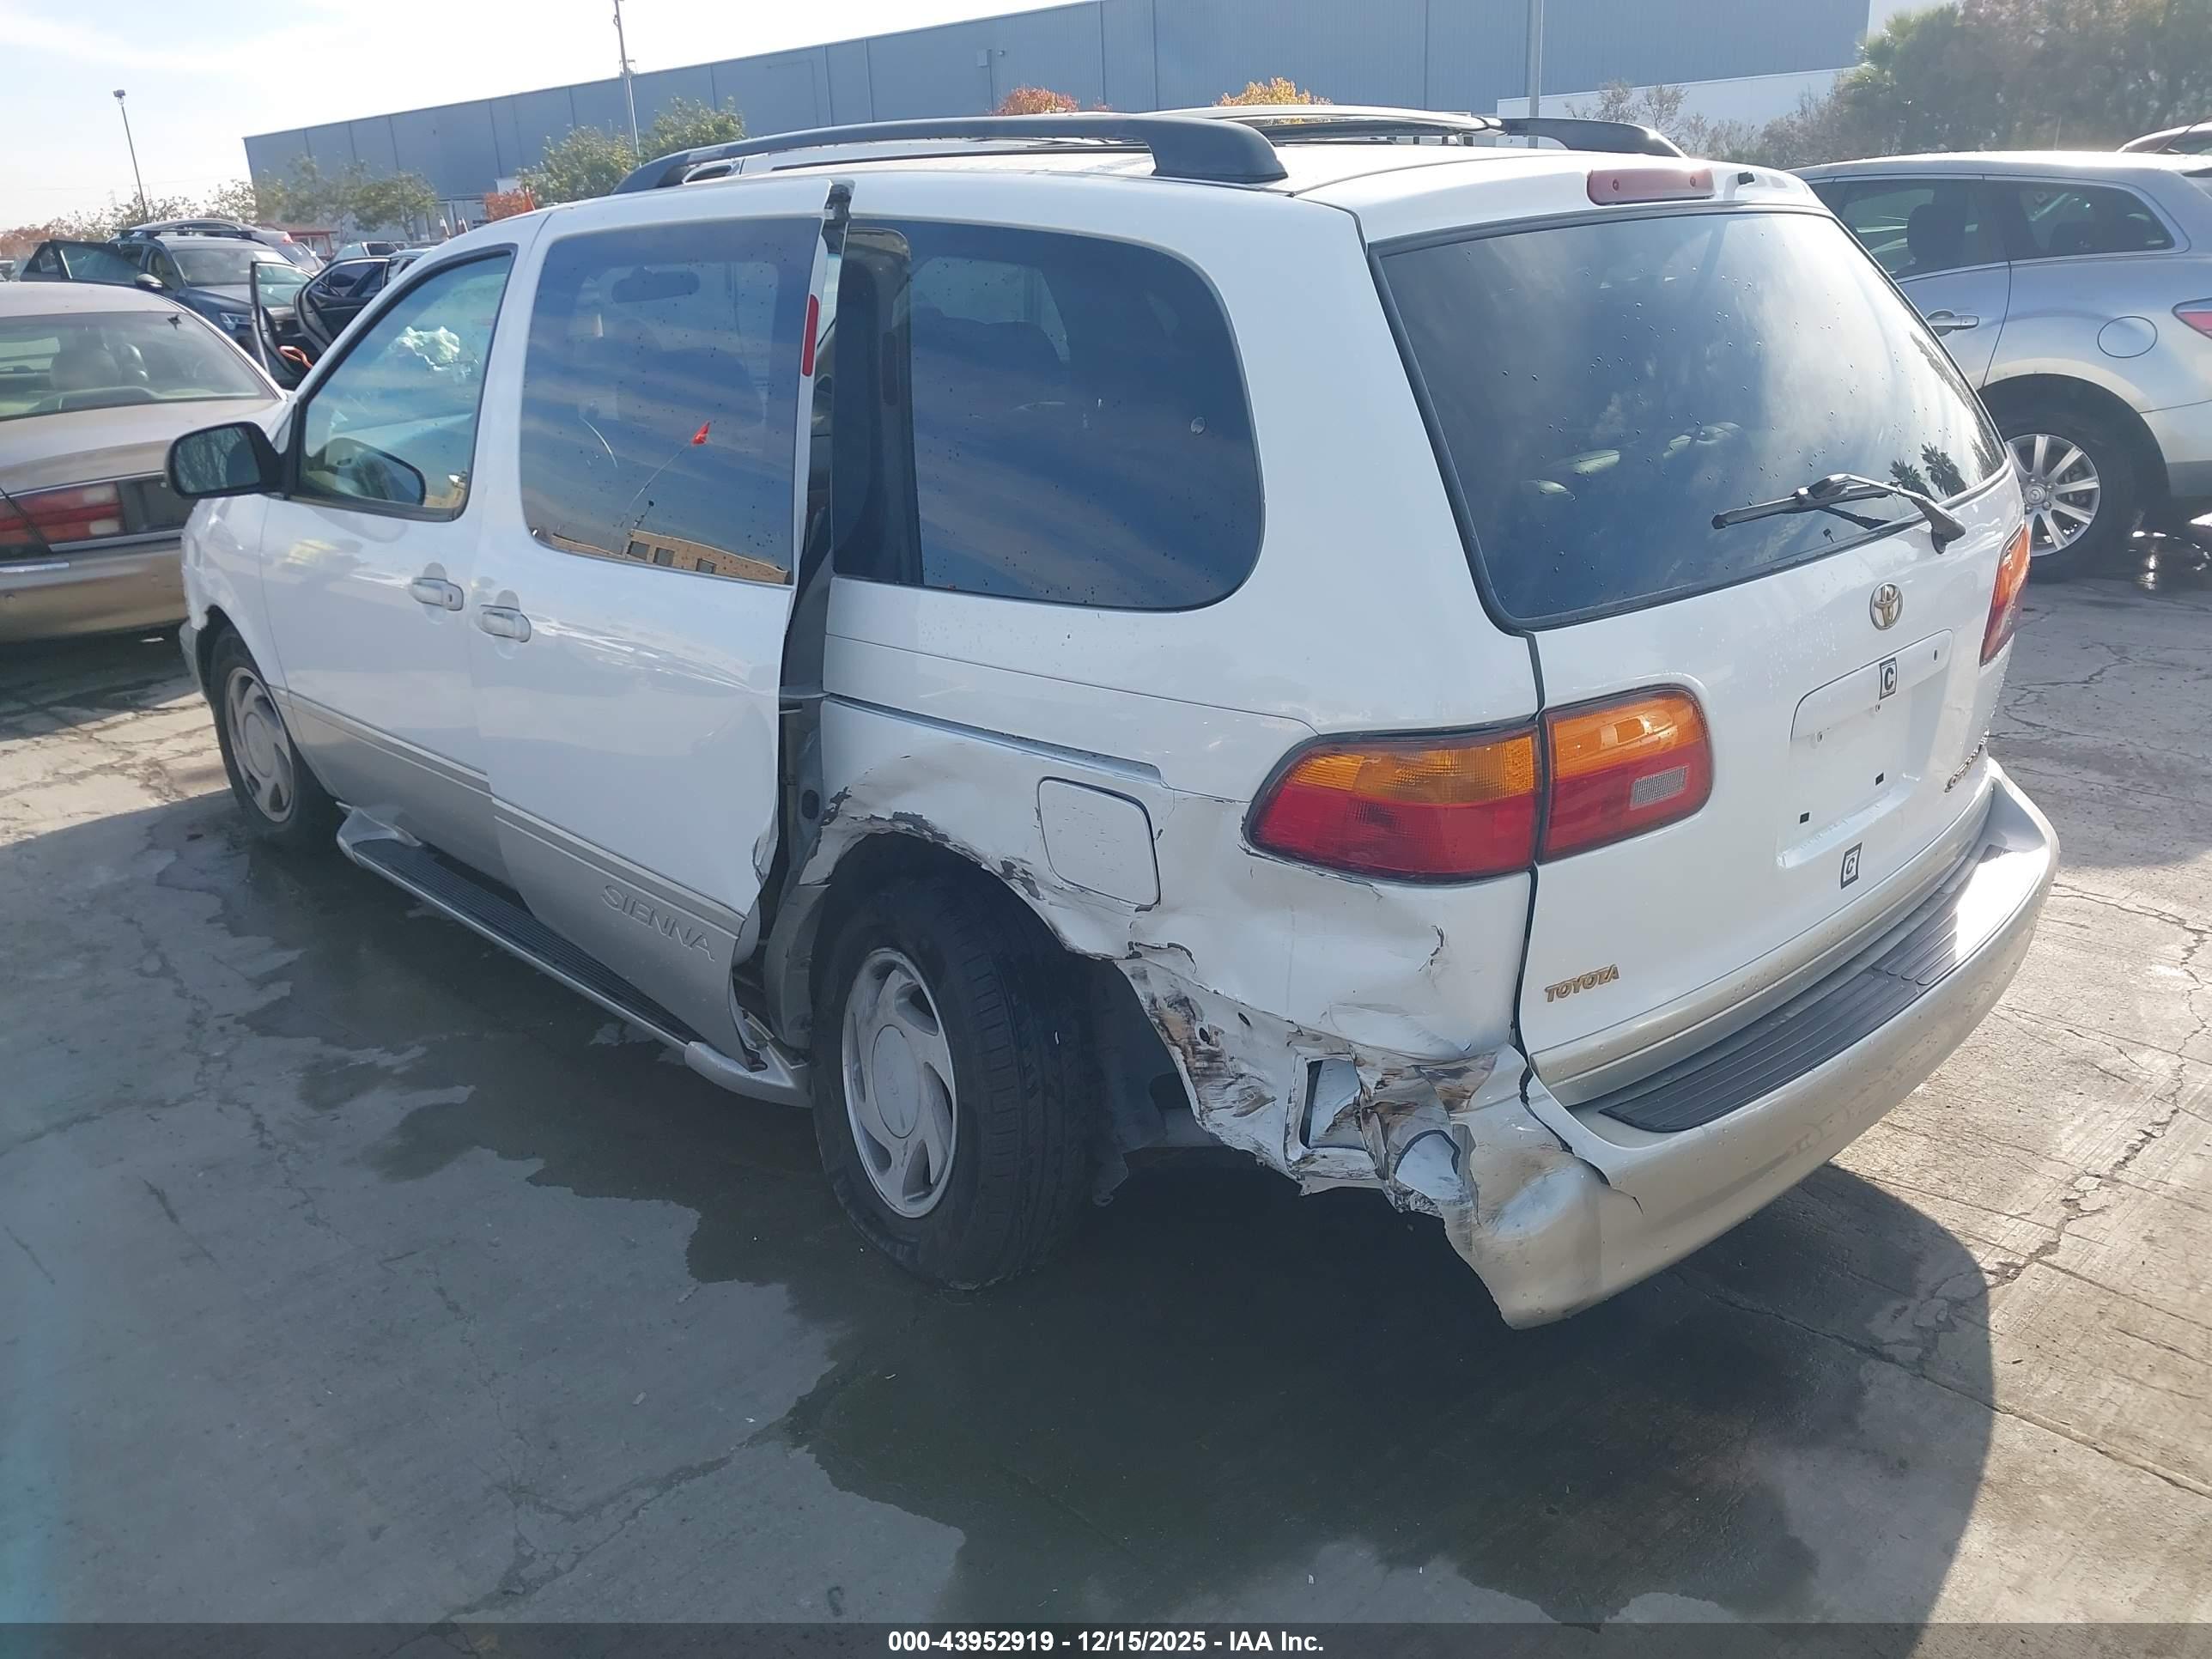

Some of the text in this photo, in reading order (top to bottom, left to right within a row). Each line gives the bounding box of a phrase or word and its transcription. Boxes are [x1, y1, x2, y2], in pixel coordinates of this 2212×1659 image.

[1884, 667, 1894, 690] C
[1846, 857, 1855, 875] C
[601, 884, 715, 962] SIENNA
[1544, 963, 1620, 1002] TOYOTA
